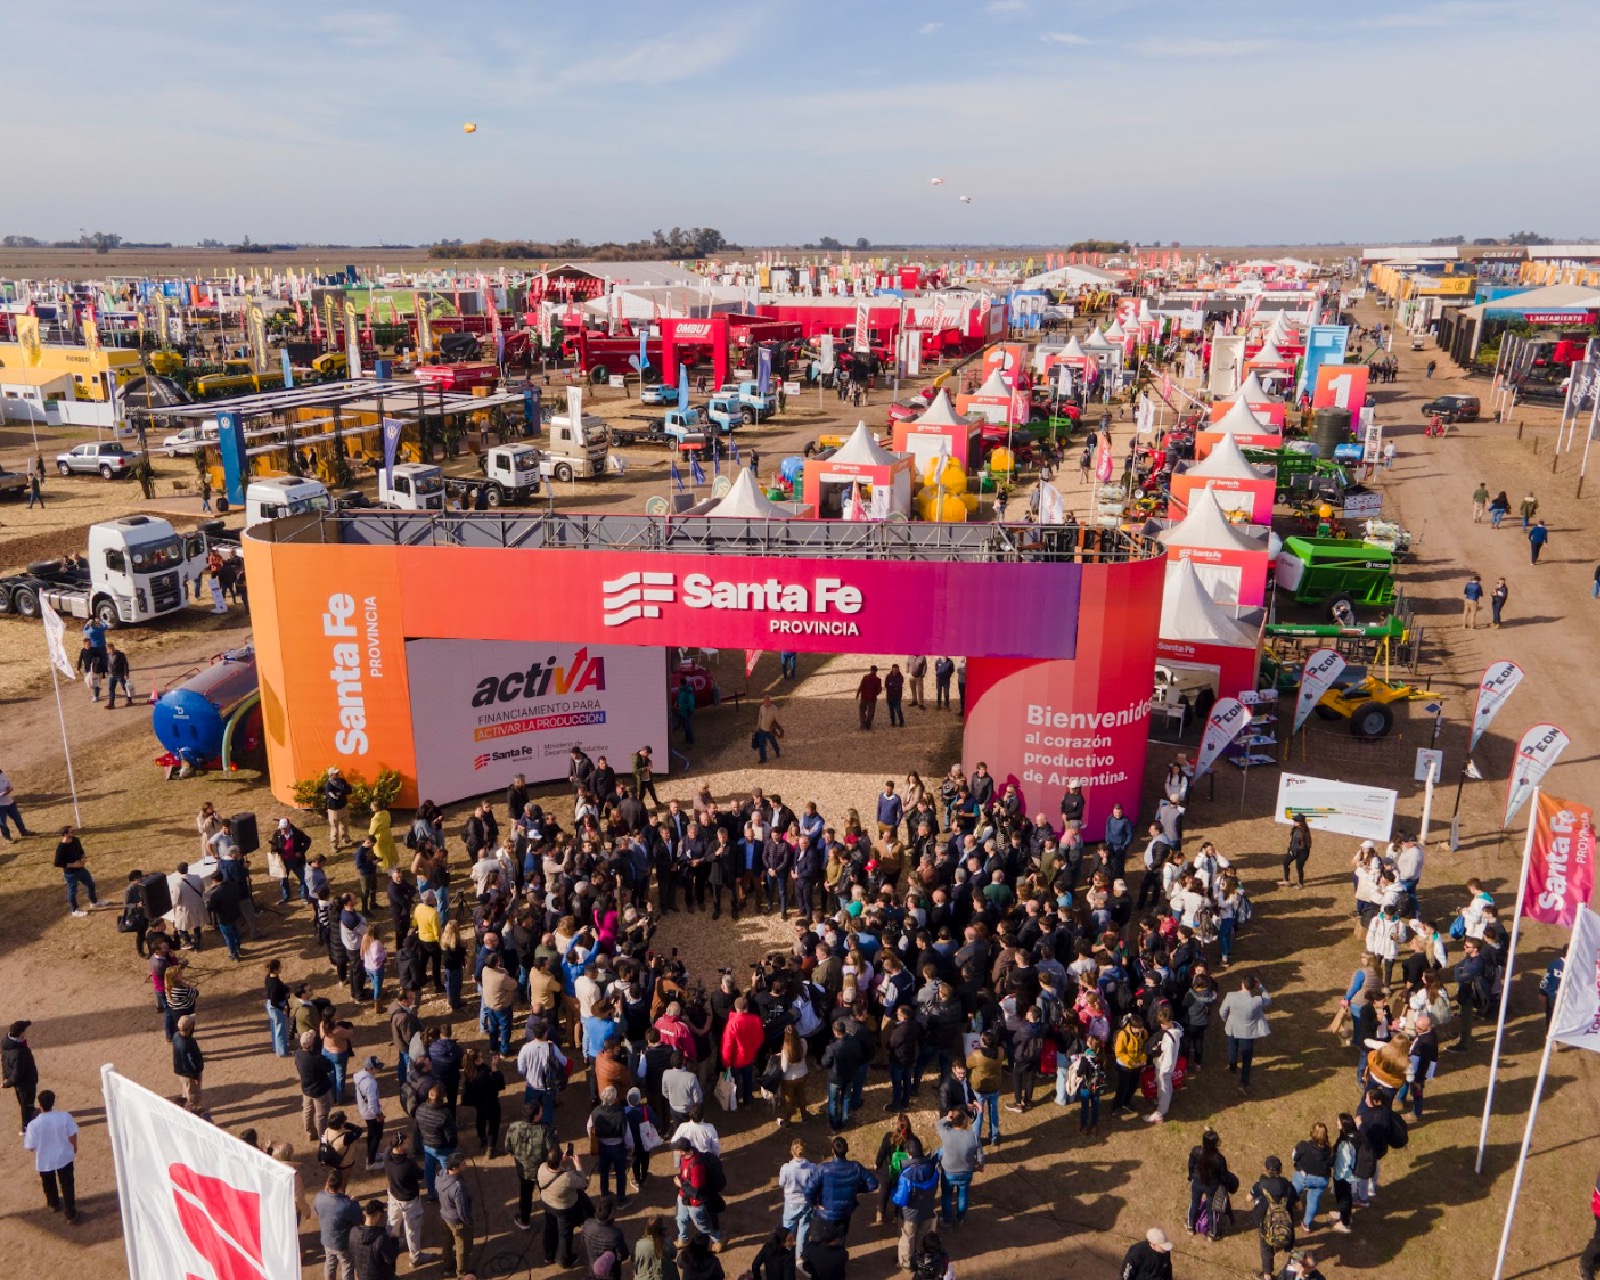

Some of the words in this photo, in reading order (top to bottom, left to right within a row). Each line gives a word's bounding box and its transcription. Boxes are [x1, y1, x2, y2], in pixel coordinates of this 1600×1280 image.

[1119, 301, 1136, 321] 3
[1529, 315, 1583, 323] LANZAMIENTO
[675, 323, 703, 335] OMBU
[988, 351, 1014, 385] 2
[1327, 373, 1352, 409] 1
[1193, 549, 1213, 558] Santa
[683, 573, 808, 612] Santa
[815, 578, 863, 614] Fe
[322, 592, 359, 637] Fe
[363, 595, 383, 678] PROVINCIA
[770, 620, 860, 636] PROVINCIA
[330, 643, 369, 756] Santa
[477, 701, 571, 726] FINANCIAMIENTO
[478, 724, 521, 740] ACTIVAR
[522, 720, 535, 732] LA
[1025, 731, 1040, 745] al
[1044, 734, 1112, 748] corazón
[492, 748, 521, 761] Santa
[521, 745, 533, 756] Fe
[1024, 752, 1115, 768] productivo
[1023, 769, 1044, 784] de
[1552, 809, 1577, 833] Fe
[1539, 834, 1571, 912] Santa
